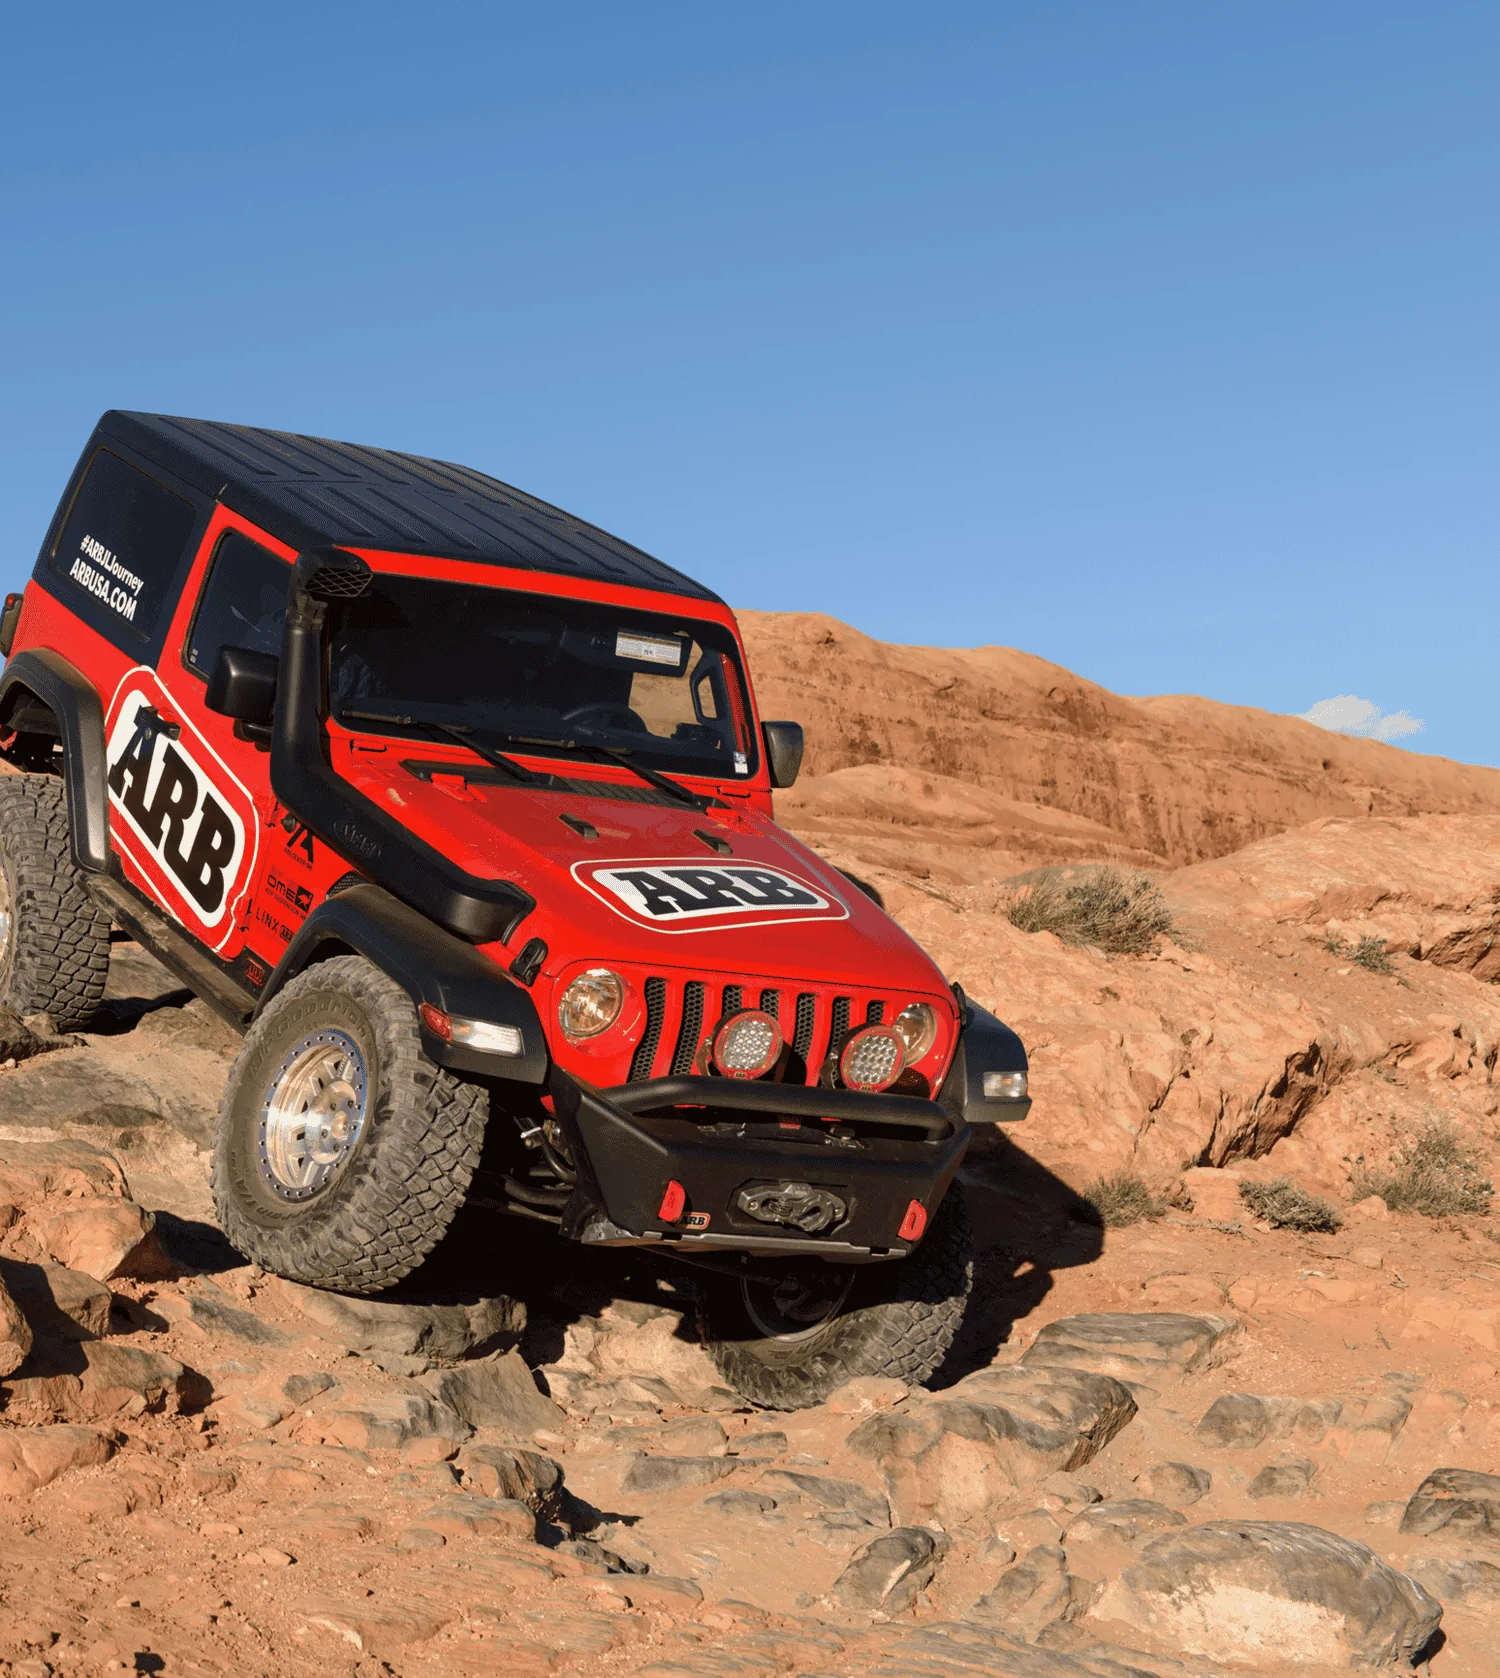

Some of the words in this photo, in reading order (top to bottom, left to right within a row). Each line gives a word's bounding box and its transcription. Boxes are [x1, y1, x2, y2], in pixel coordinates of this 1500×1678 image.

[69, 557, 138, 621] ARBUSA.COM
[80, 534, 144, 597] #ARBJLJourney
[107, 705, 236, 914] ARB
[256, 906, 280, 934] LINX
[609, 869, 819, 916] ARB
[680, 1215, 706, 1226] ARB
